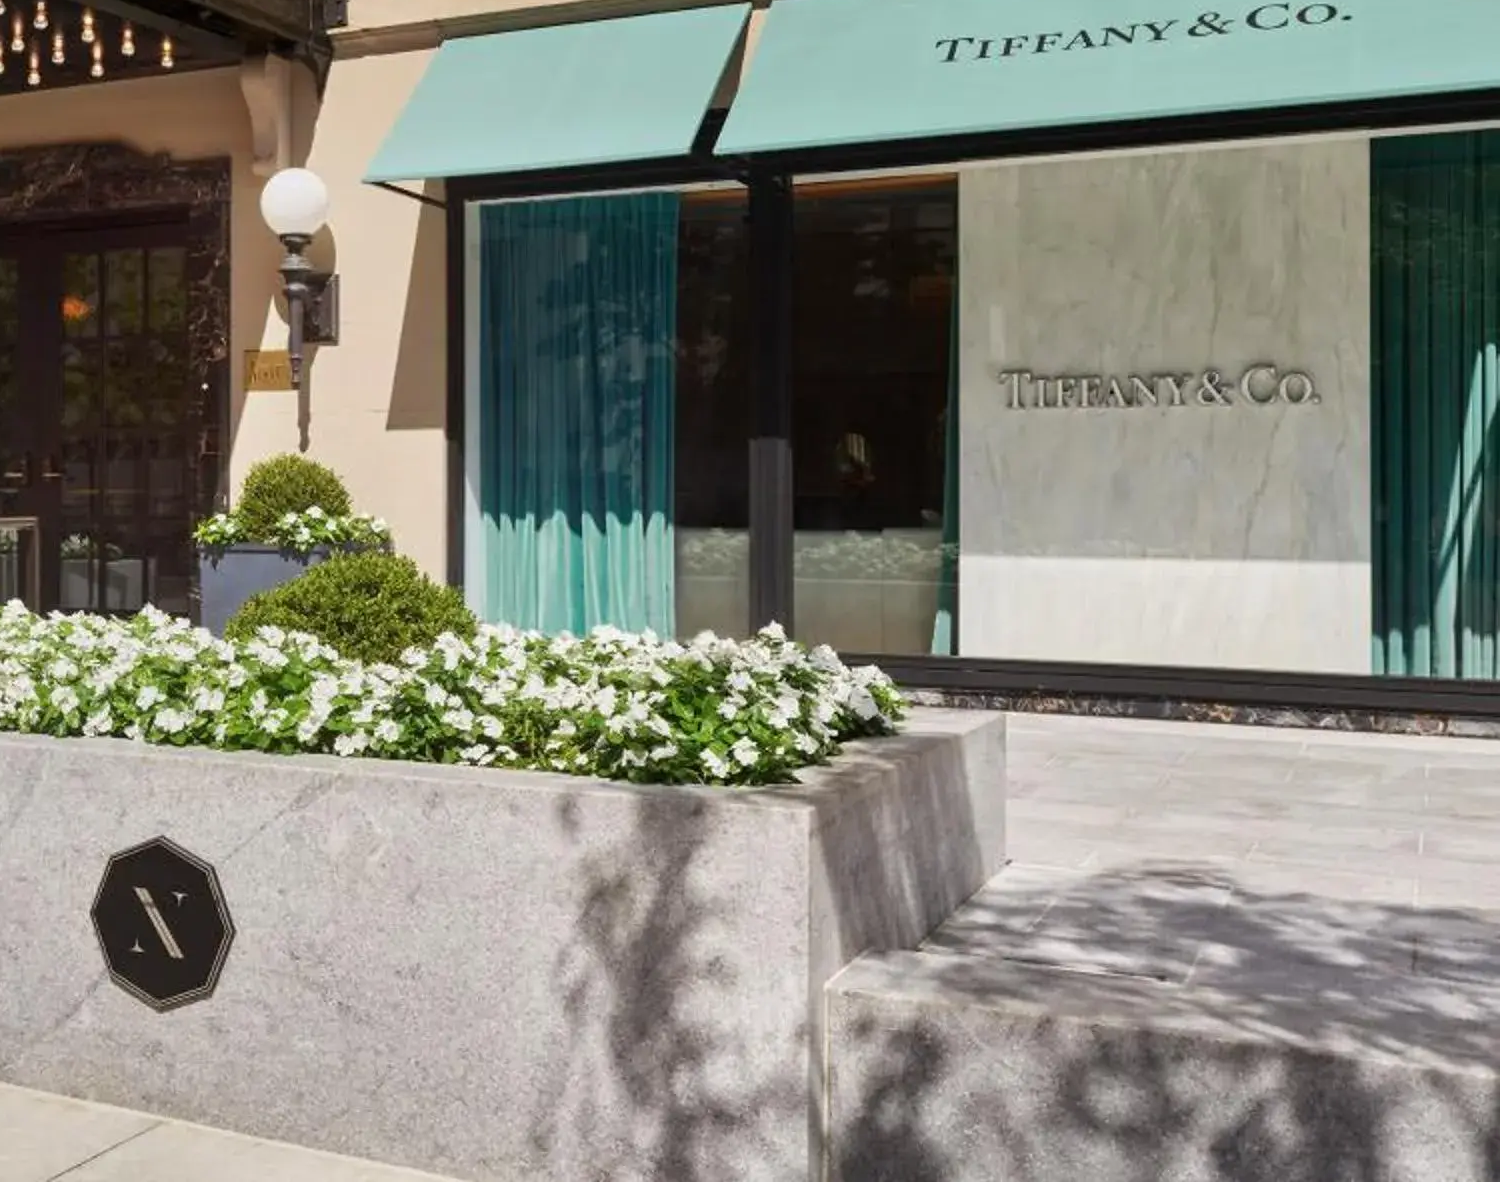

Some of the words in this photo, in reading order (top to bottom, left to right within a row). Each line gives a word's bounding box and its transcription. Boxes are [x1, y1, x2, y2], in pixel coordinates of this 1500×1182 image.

[936, 19, 1180, 63] TIFFANY
[1188, 11, 1235, 37] &
[1246, 2, 1353, 31] CO.
[999, 369, 1194, 409] TIFFANY
[1198, 367, 1234, 407] &
[1240, 362, 1321, 406] CO.
